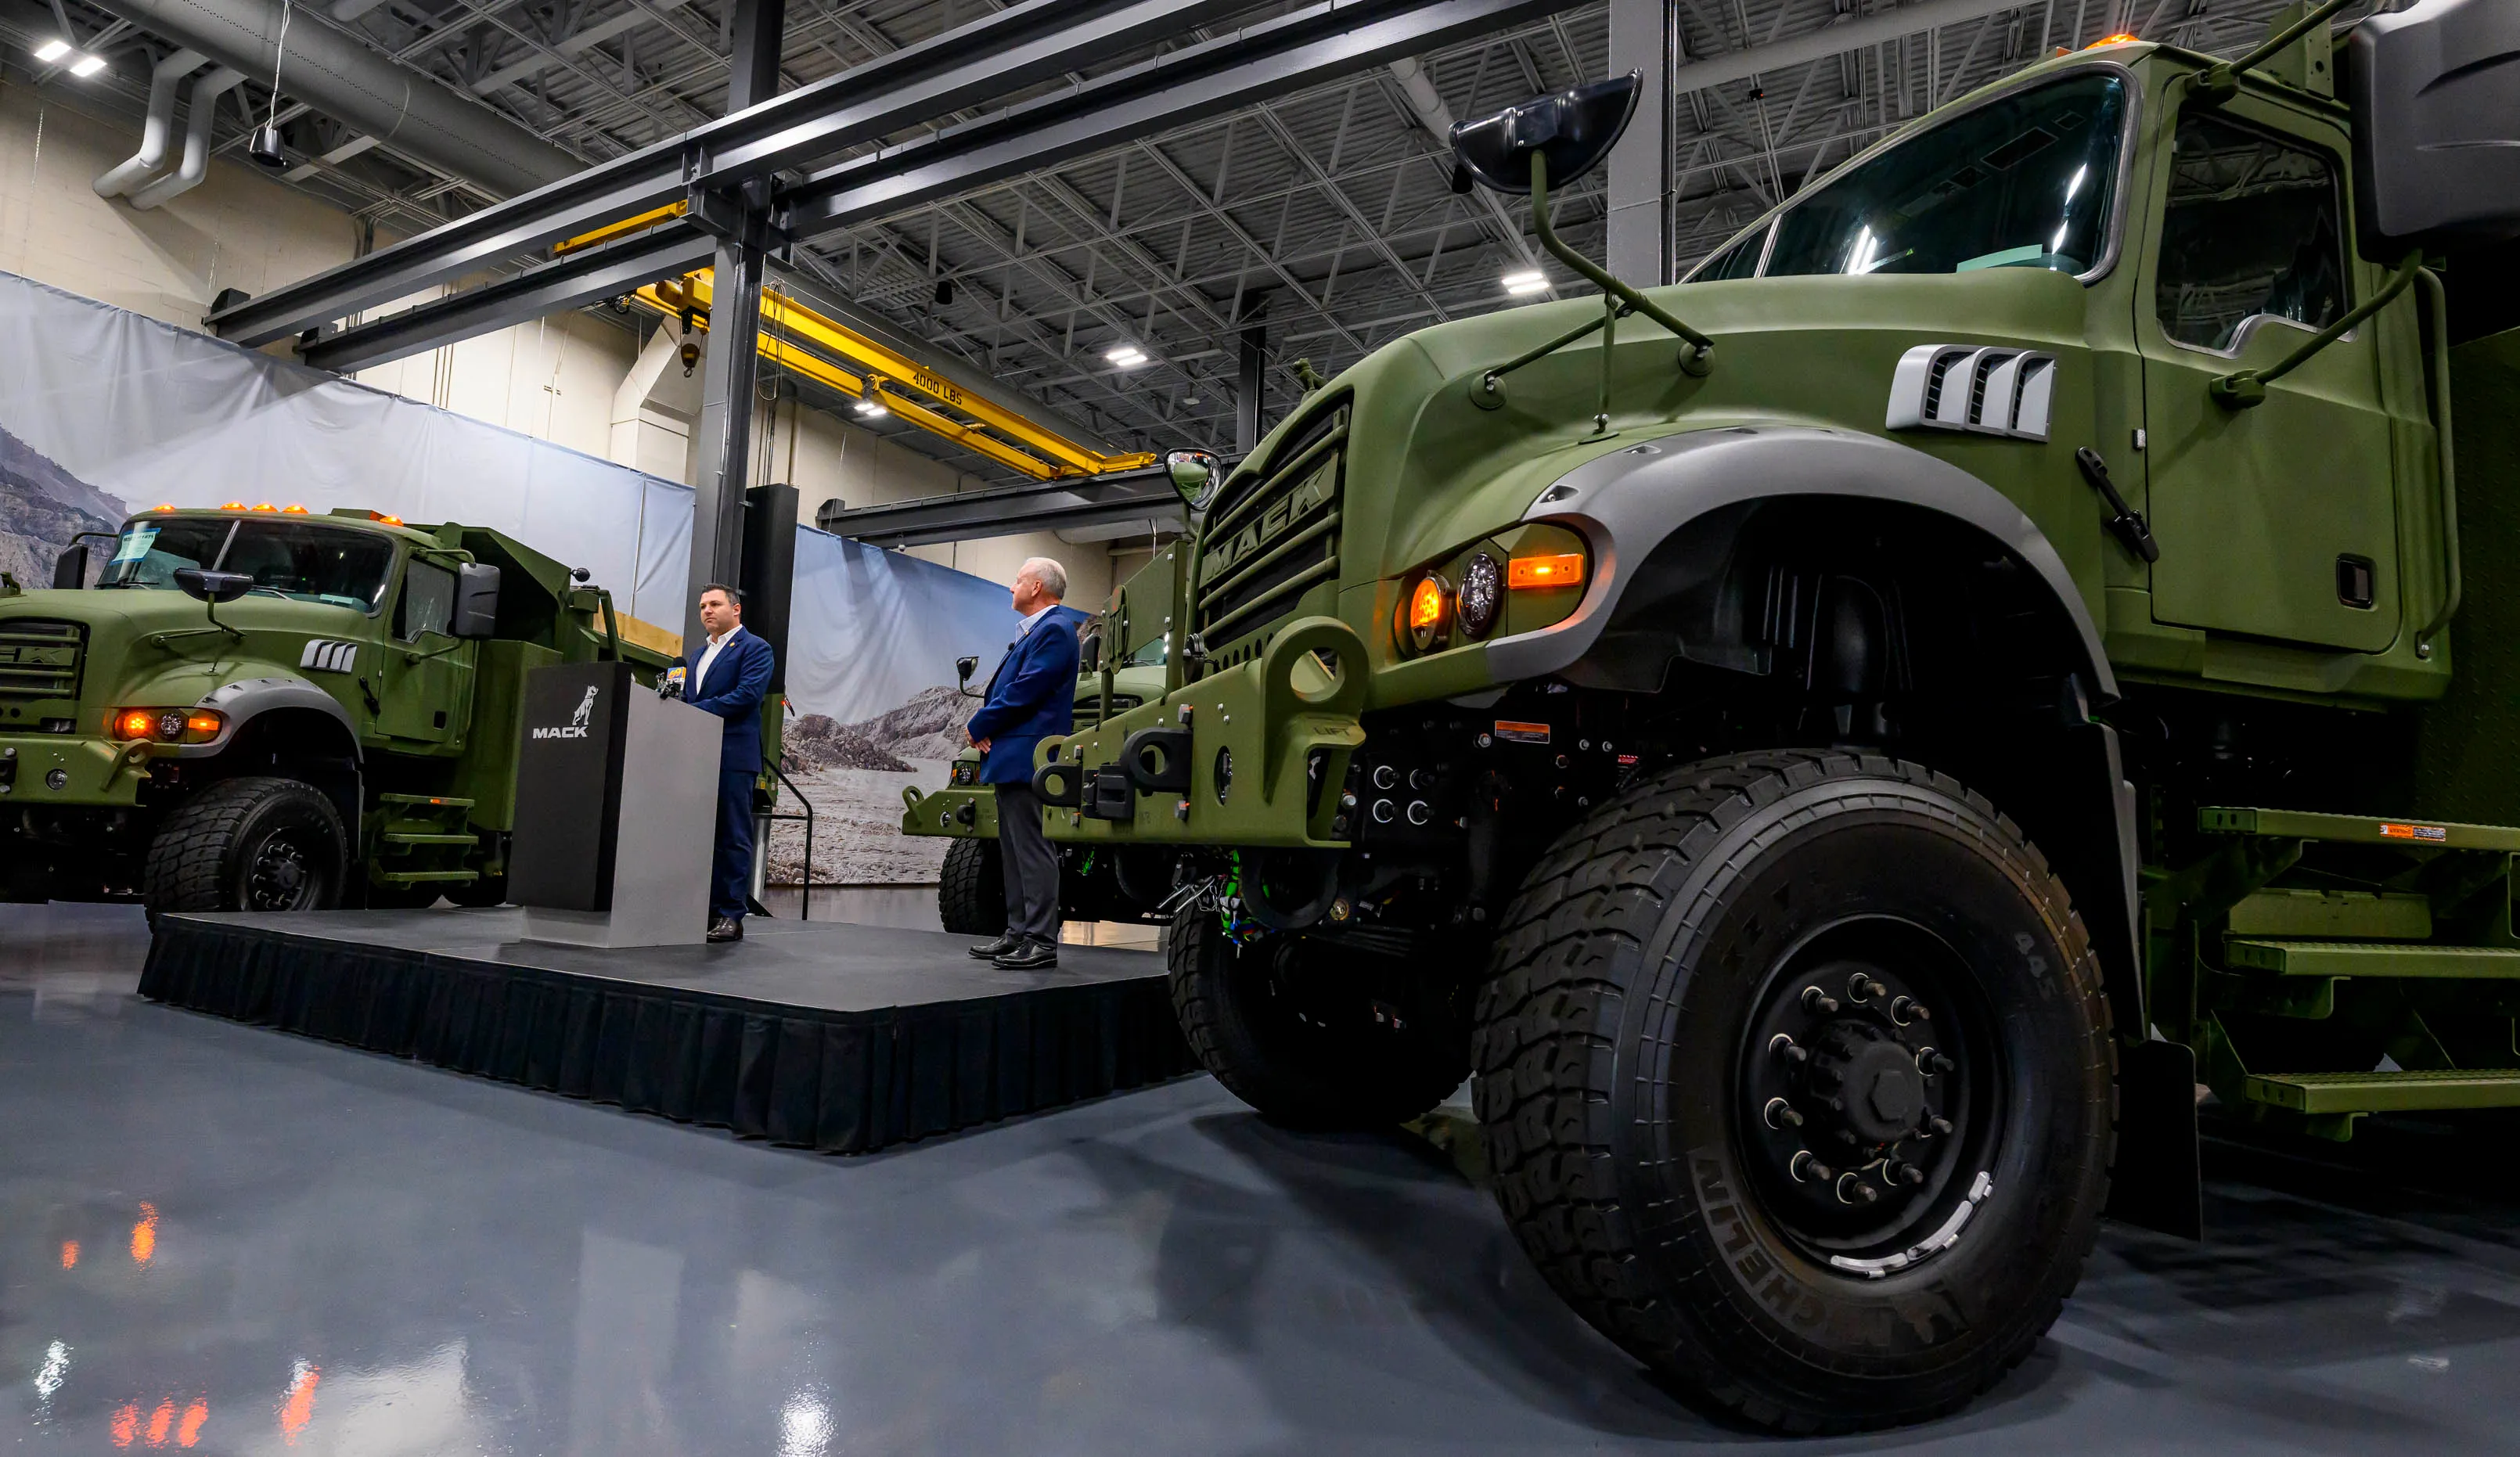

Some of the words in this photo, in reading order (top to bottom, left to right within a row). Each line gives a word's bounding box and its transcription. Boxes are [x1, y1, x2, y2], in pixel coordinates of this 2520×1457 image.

[913, 372, 939, 394] 4000
[943, 385, 963, 405] LBS
[1201, 463, 1334, 585] MACK
[532, 726, 589, 739] MACK
